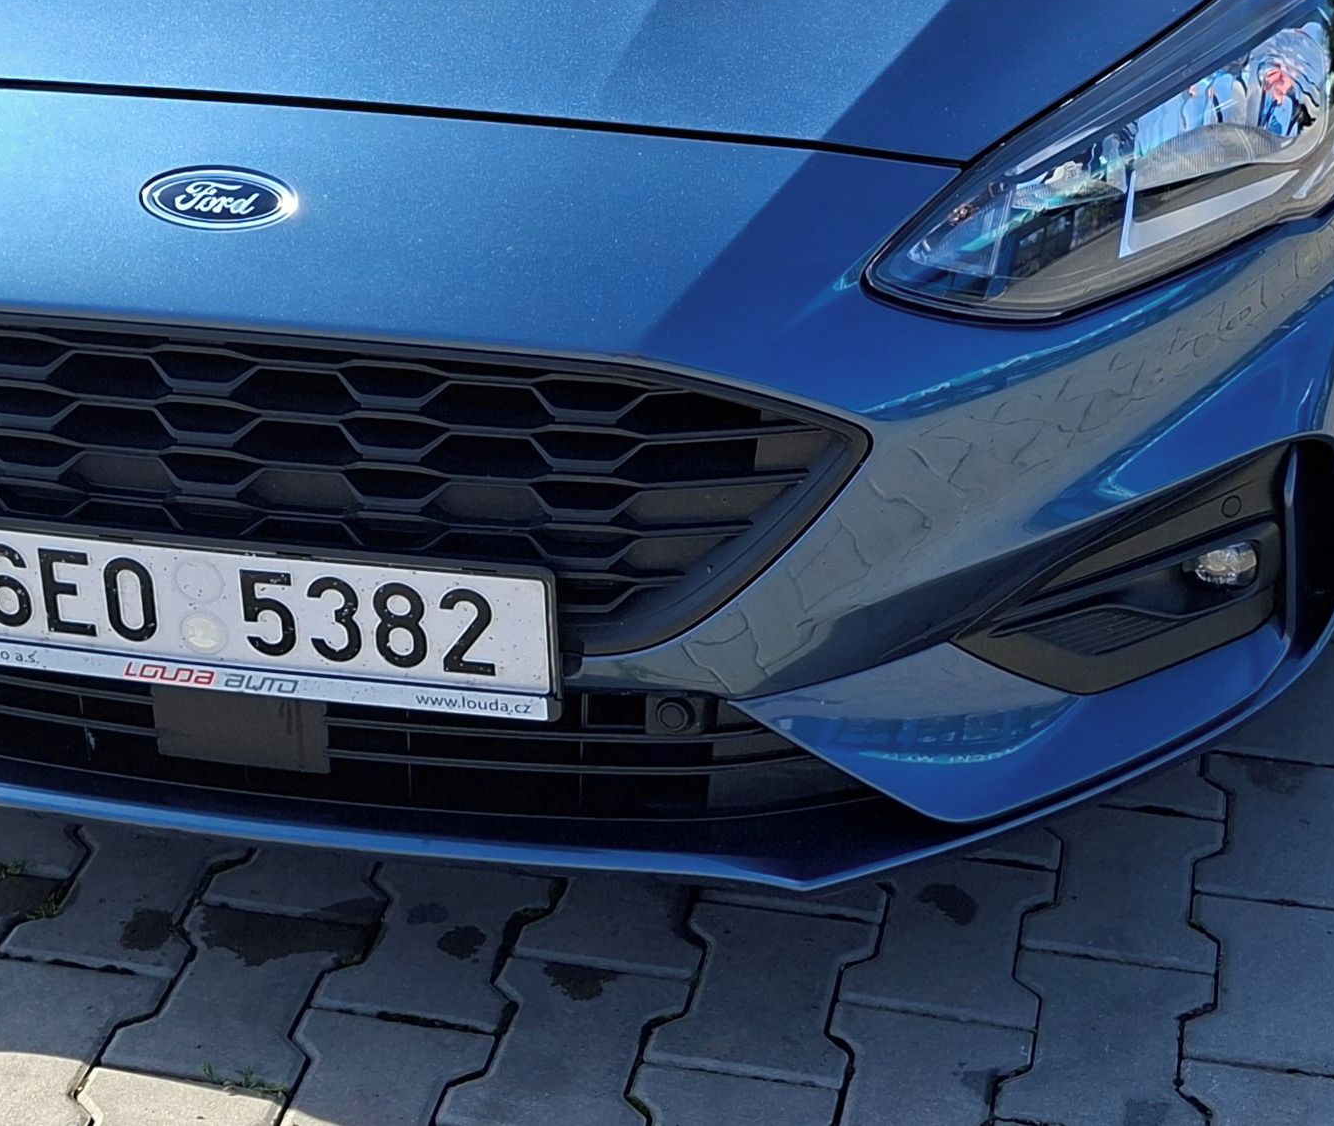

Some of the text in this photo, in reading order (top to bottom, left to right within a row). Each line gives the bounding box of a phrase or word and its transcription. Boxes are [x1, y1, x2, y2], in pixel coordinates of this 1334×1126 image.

[175, 181, 259, 215] Ford
[238, 569, 496, 677] 5382
[415, 694, 532, 714] www.louda.cz
